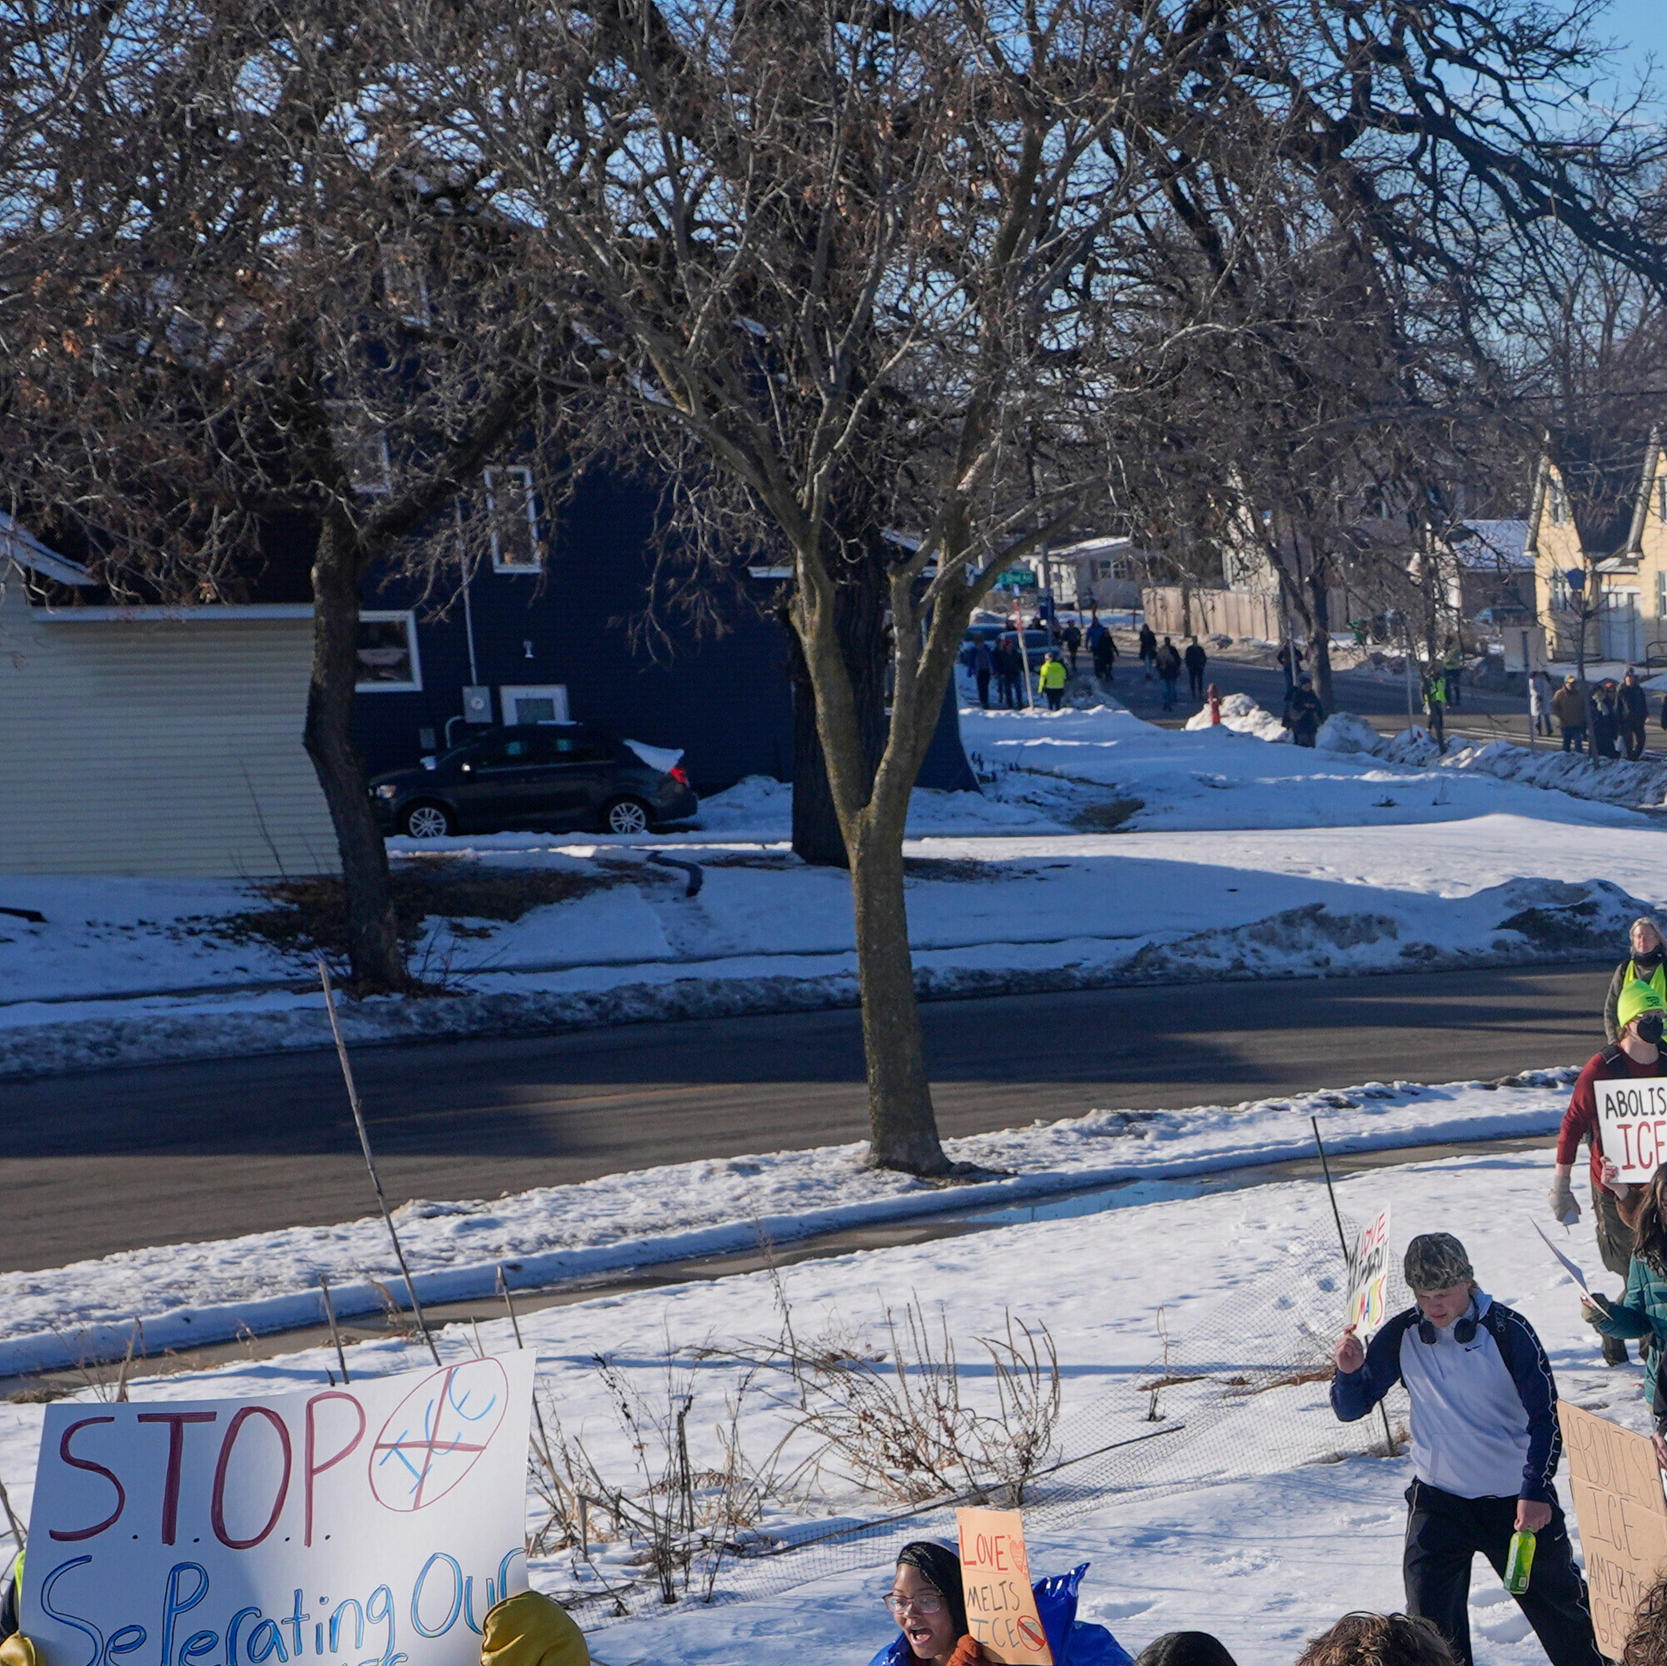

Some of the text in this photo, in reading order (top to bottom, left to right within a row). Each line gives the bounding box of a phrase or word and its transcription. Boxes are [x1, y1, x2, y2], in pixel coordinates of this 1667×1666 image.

[1616, 1120, 1667, 1171] ICE
[379, 1365, 498, 1495] ICE
[1566, 1412, 1666, 1517] ABOLISH
[959, 1525, 1009, 1571] LOVE
[1587, 1486, 1642, 1561] ICE
[966, 1580, 1021, 1613] MELTS
[969, 1616, 1020, 1649] ICE
